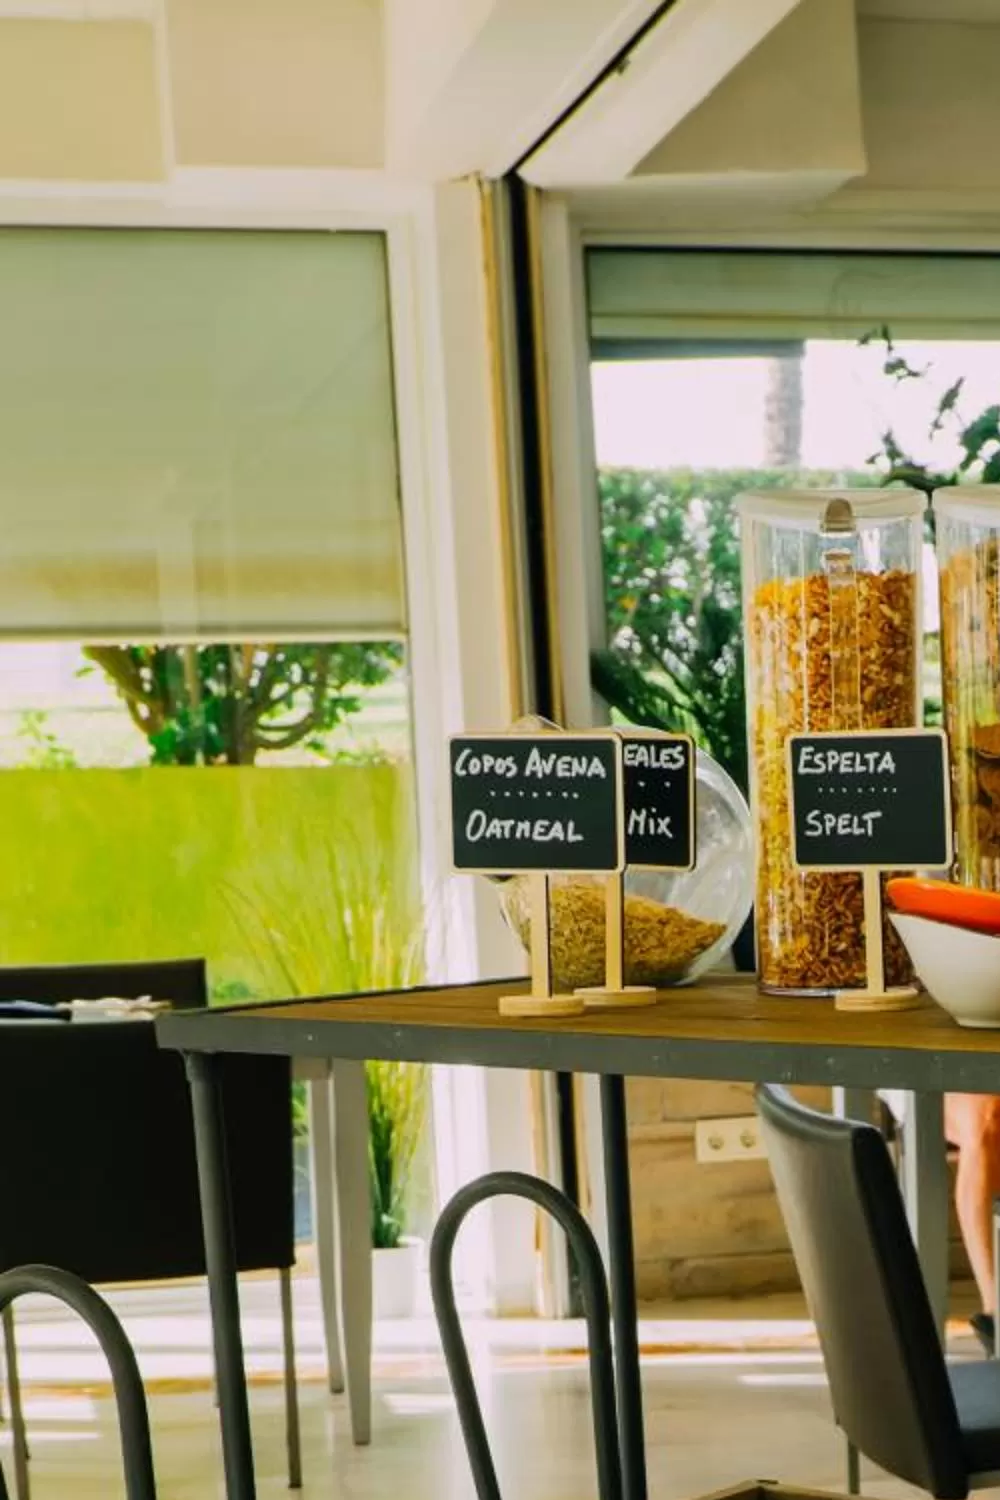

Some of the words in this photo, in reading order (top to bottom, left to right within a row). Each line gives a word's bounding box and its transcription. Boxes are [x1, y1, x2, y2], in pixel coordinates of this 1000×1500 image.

[525, 748, 606, 779] AVENA
[624, 743, 685, 770] EALES
[798, 746, 897, 775] ESPELTA
[465, 809, 584, 843] OATMEAL
[805, 811, 883, 837] SPELT
